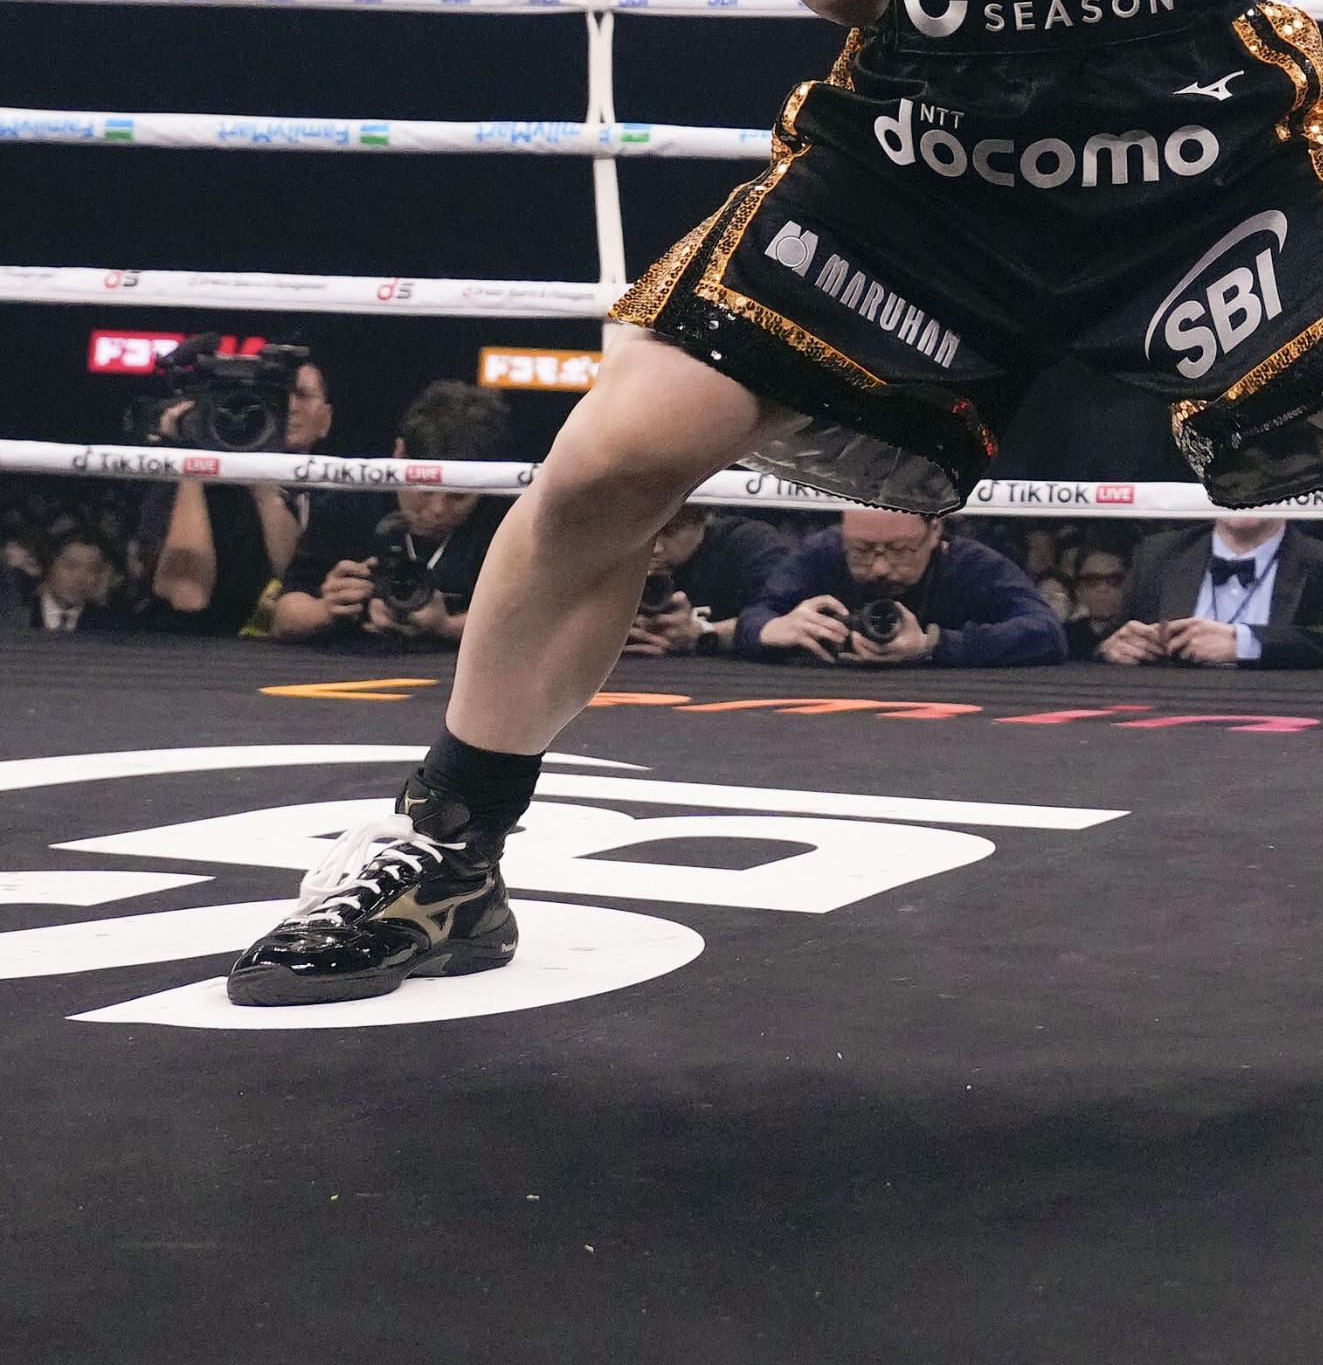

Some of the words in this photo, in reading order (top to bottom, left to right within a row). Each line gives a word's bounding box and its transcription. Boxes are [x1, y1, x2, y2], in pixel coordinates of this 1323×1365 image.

[874, 97, 1219, 188] docomo
[920, 103, 965, 129] NTT
[814, 253, 962, 369] MARUHAN
[1163, 247, 1285, 379] SBI
[323, 462, 400, 483] TikTok
[1007, 483, 1089, 504] TikTok
[1098, 487, 1132, 502] LIVE
